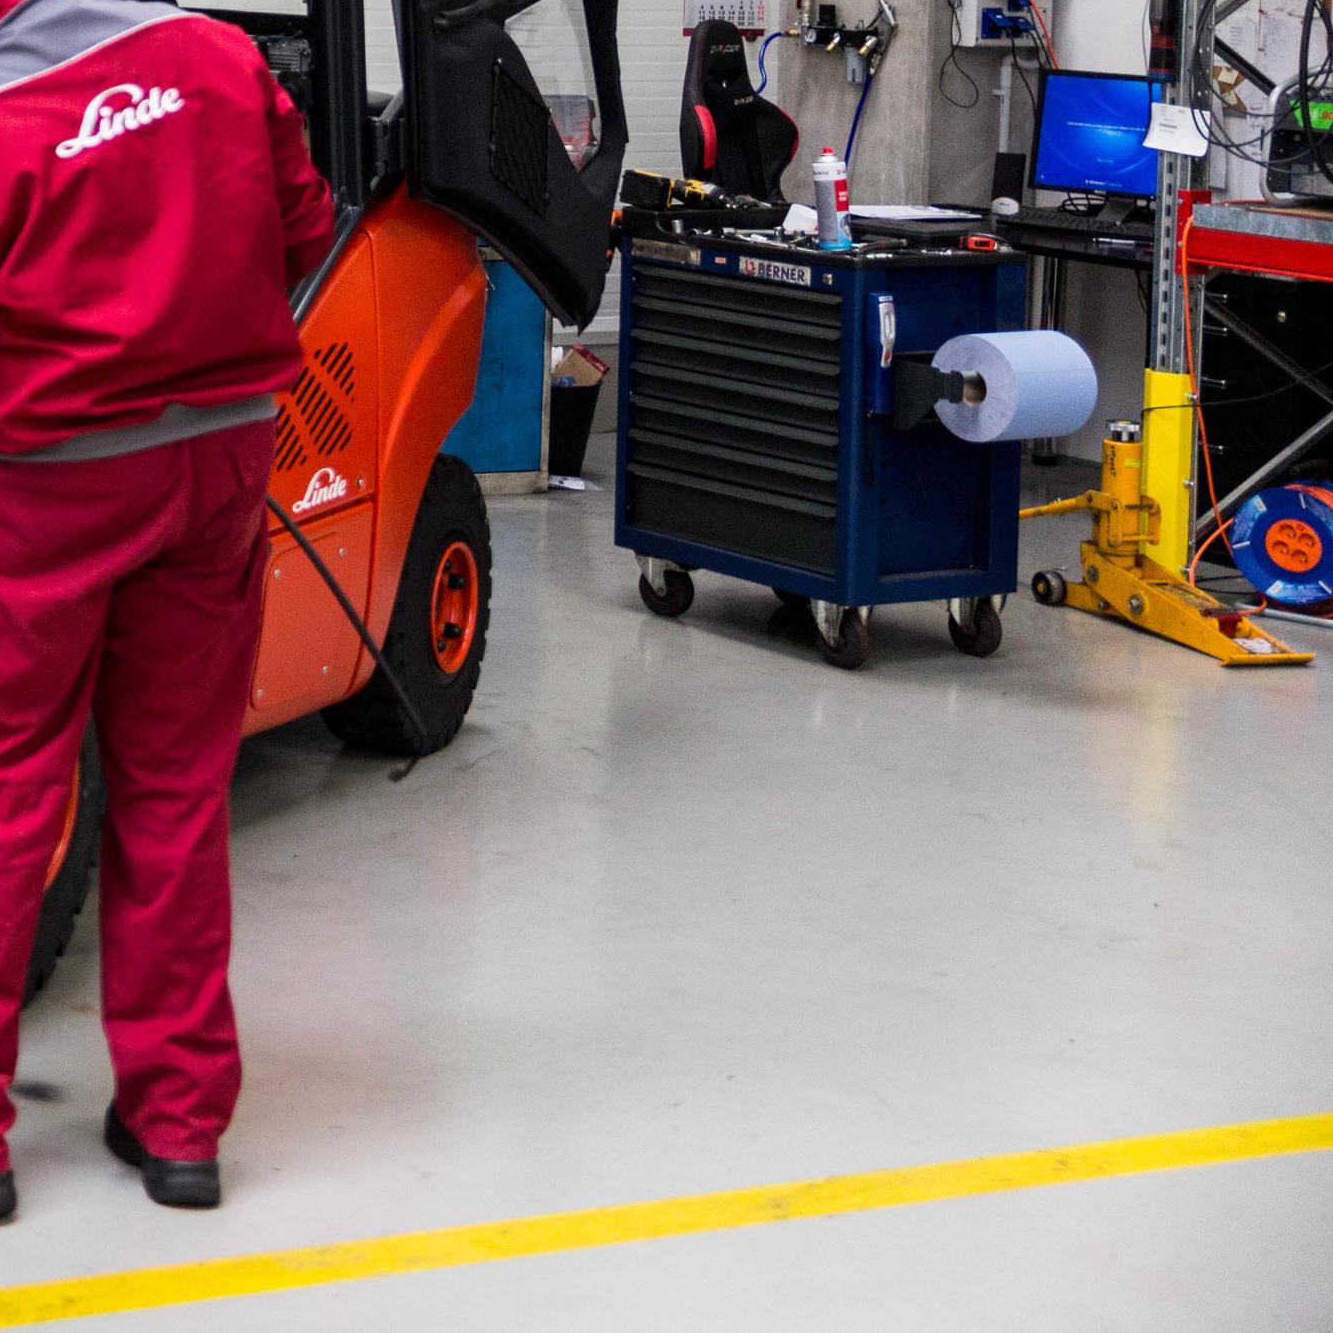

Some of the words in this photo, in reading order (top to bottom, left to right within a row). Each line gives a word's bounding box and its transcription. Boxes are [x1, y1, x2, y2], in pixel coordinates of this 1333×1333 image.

[55, 83, 185, 159] Linde
[758, 262, 805, 282] BERNER
[292, 466, 348, 513] Linde
